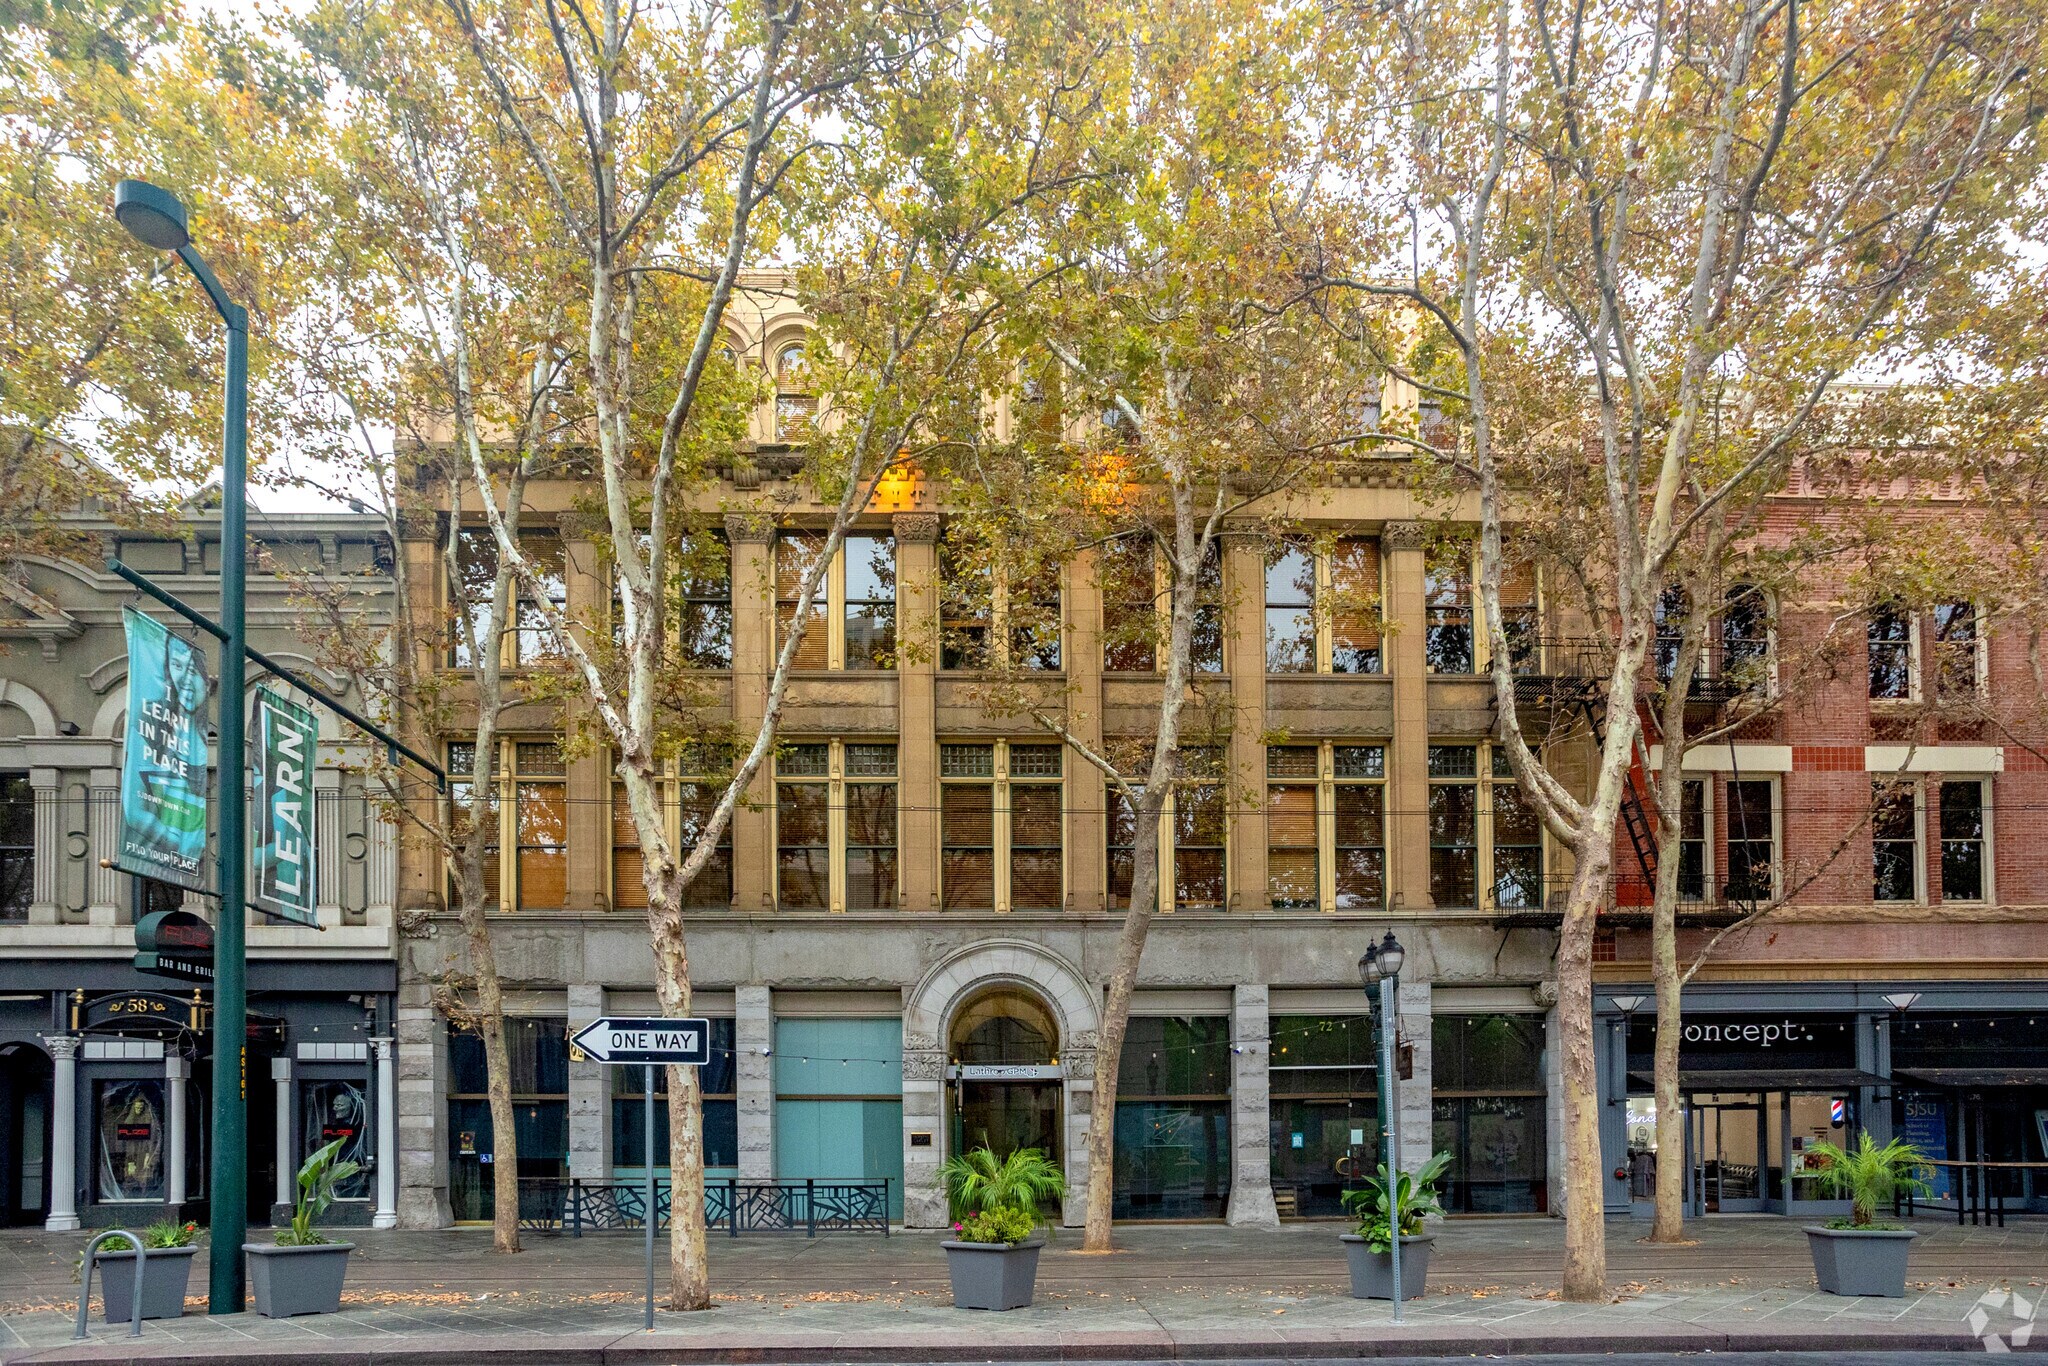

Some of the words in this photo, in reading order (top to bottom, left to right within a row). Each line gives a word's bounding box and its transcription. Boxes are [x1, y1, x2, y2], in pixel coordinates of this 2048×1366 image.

[165, 685, 172, 702] I
[142, 698, 189, 733] LEARN
[138, 719, 155, 741] IN
[161, 730, 190, 756] THIS
[143, 745, 188, 777] PLACE
[275, 723, 304, 897] LEARN
[126, 841, 146, 855] FIND
[149, 848, 170, 863] YOUR
[173, 856, 197, 872] PLACE
[160, 958, 174, 969] BAR
[177, 962, 192, 973] AND
[127, 998, 148, 1013] 58
[1319, 1021, 1333, 1032] 72
[1680, 1020, 1814, 1047] oncept.
[611, 1033, 648, 1049] ONE
[655, 1034, 693, 1049] WAY
[1906, 1101, 1937, 1117] SJSU
